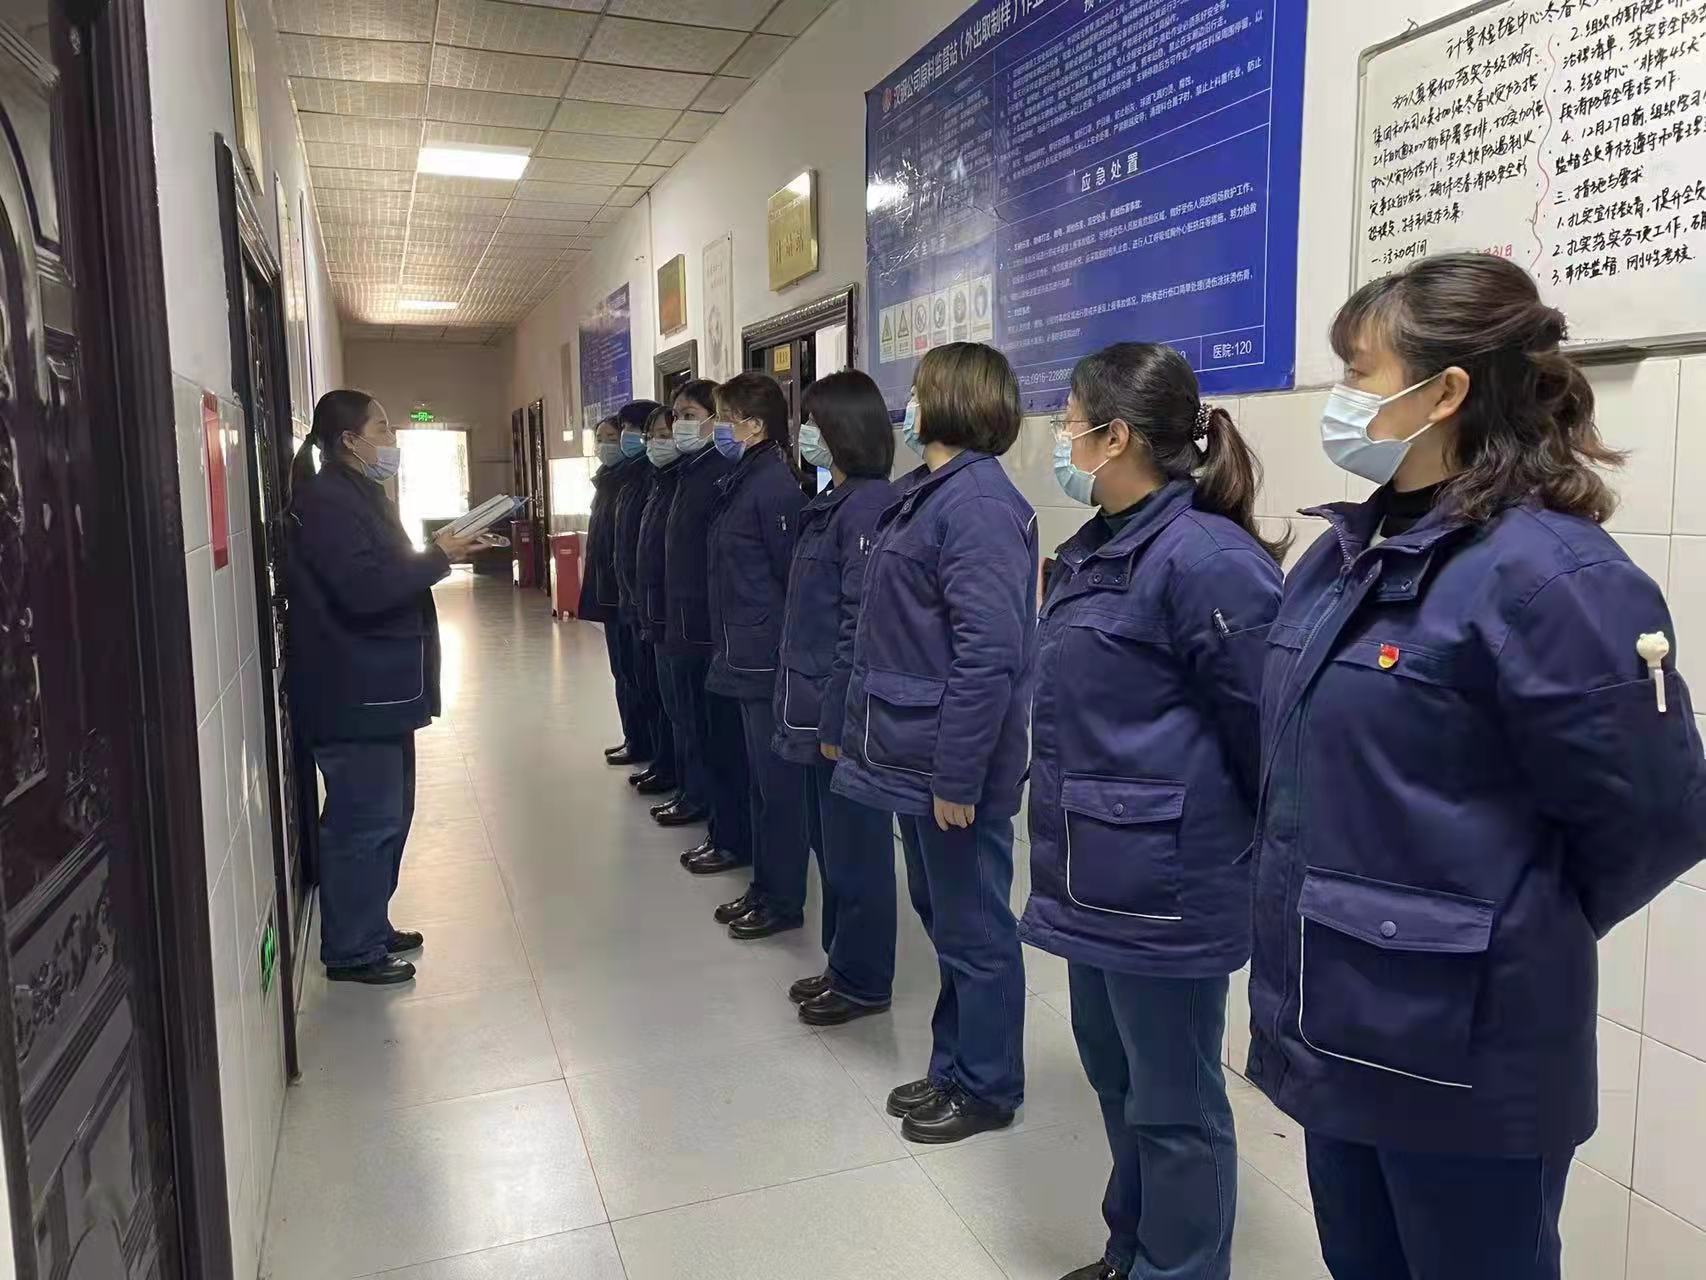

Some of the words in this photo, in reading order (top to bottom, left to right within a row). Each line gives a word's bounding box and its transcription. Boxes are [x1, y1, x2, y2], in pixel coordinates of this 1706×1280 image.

[1080, 150, 1140, 194] 应急处置
[1212, 340, 1252, 359] 医院:120
